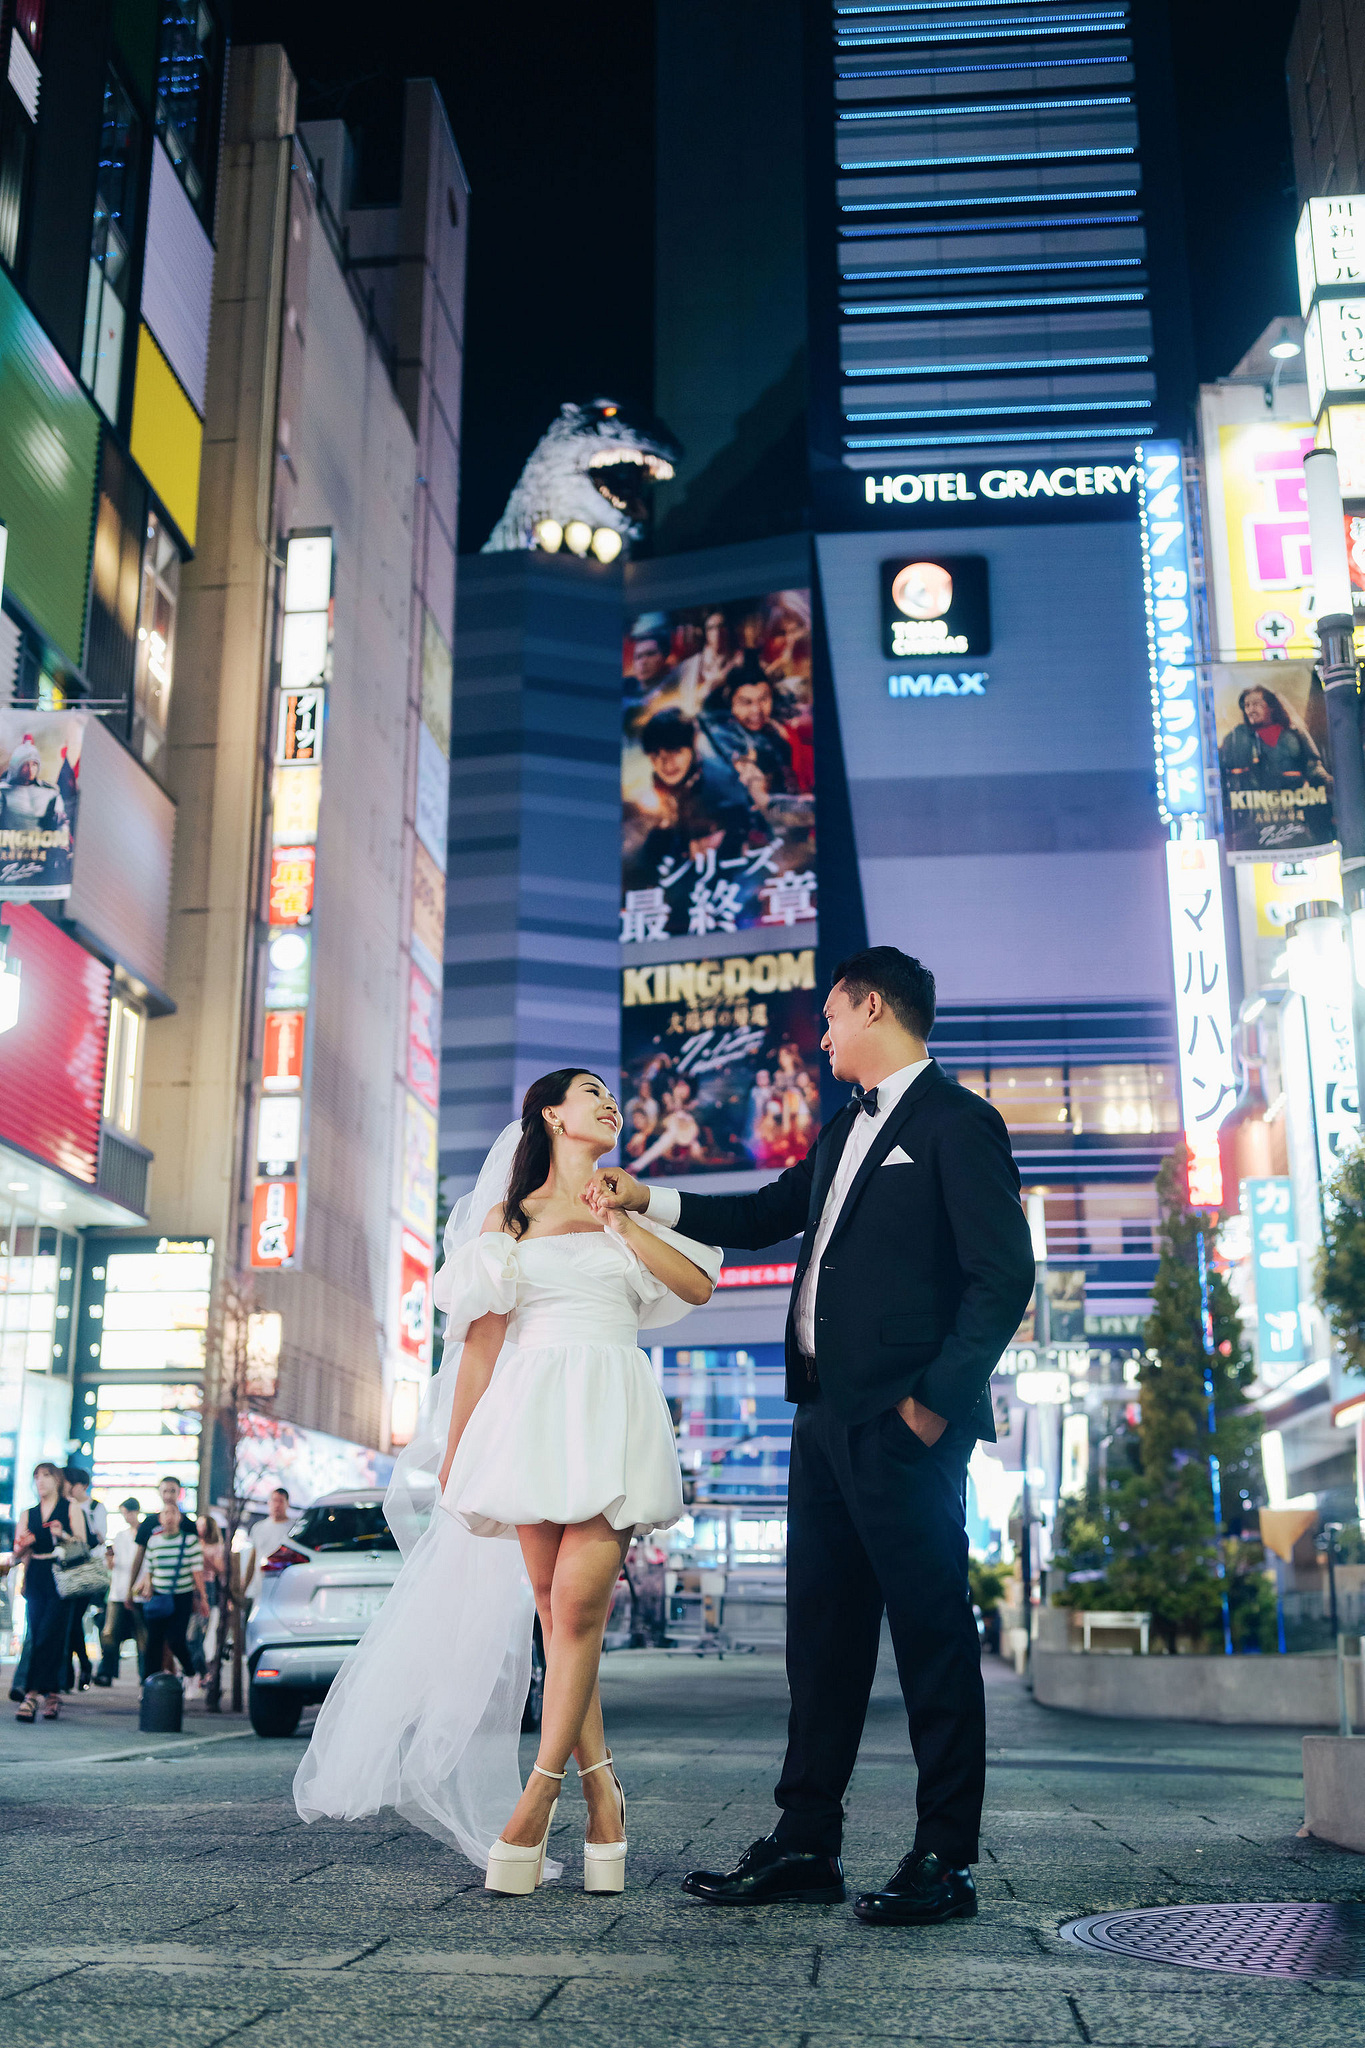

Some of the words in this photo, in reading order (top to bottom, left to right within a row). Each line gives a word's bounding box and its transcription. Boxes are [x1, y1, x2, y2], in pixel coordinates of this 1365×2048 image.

[865, 472, 977, 504] HOTEL
[979, 464, 1137, 499] GRACERY
[1145, 453, 1184, 556] 747
[888, 672, 986, 698] IMAX
[1152, 565, 1198, 802] カラオケランド
[1230, 786, 1328, 811] KINGDOM
[656, 837, 785, 888] シリーズ
[618, 869, 818, 943] 最終章
[623, 949, 816, 1008] KINGDOM
[1181, 889, 1237, 1123] マルハン
